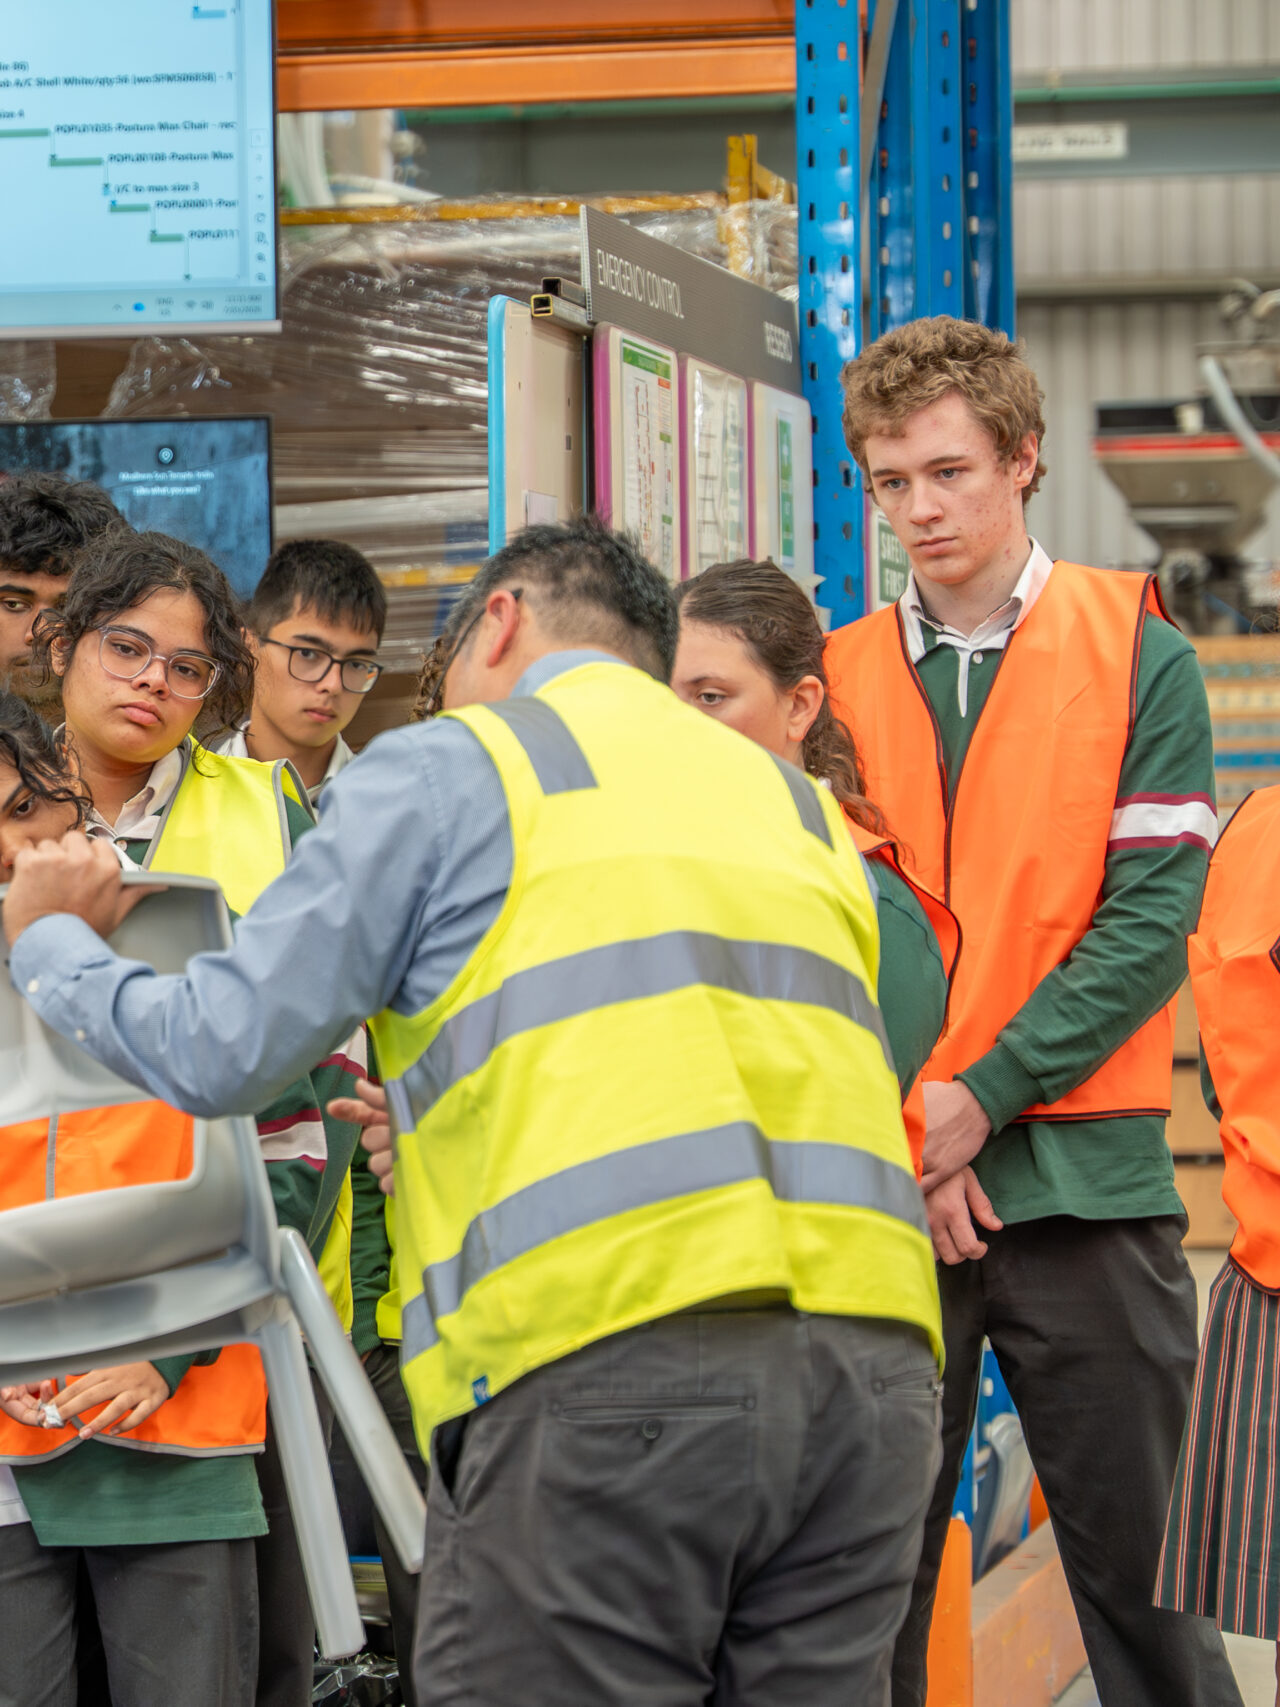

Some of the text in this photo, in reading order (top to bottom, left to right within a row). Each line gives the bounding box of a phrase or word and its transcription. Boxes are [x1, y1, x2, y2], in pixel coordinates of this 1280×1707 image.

[597, 248, 685, 319] EMERGENCY CONTROL
[884, 567, 905, 597] FIRST
